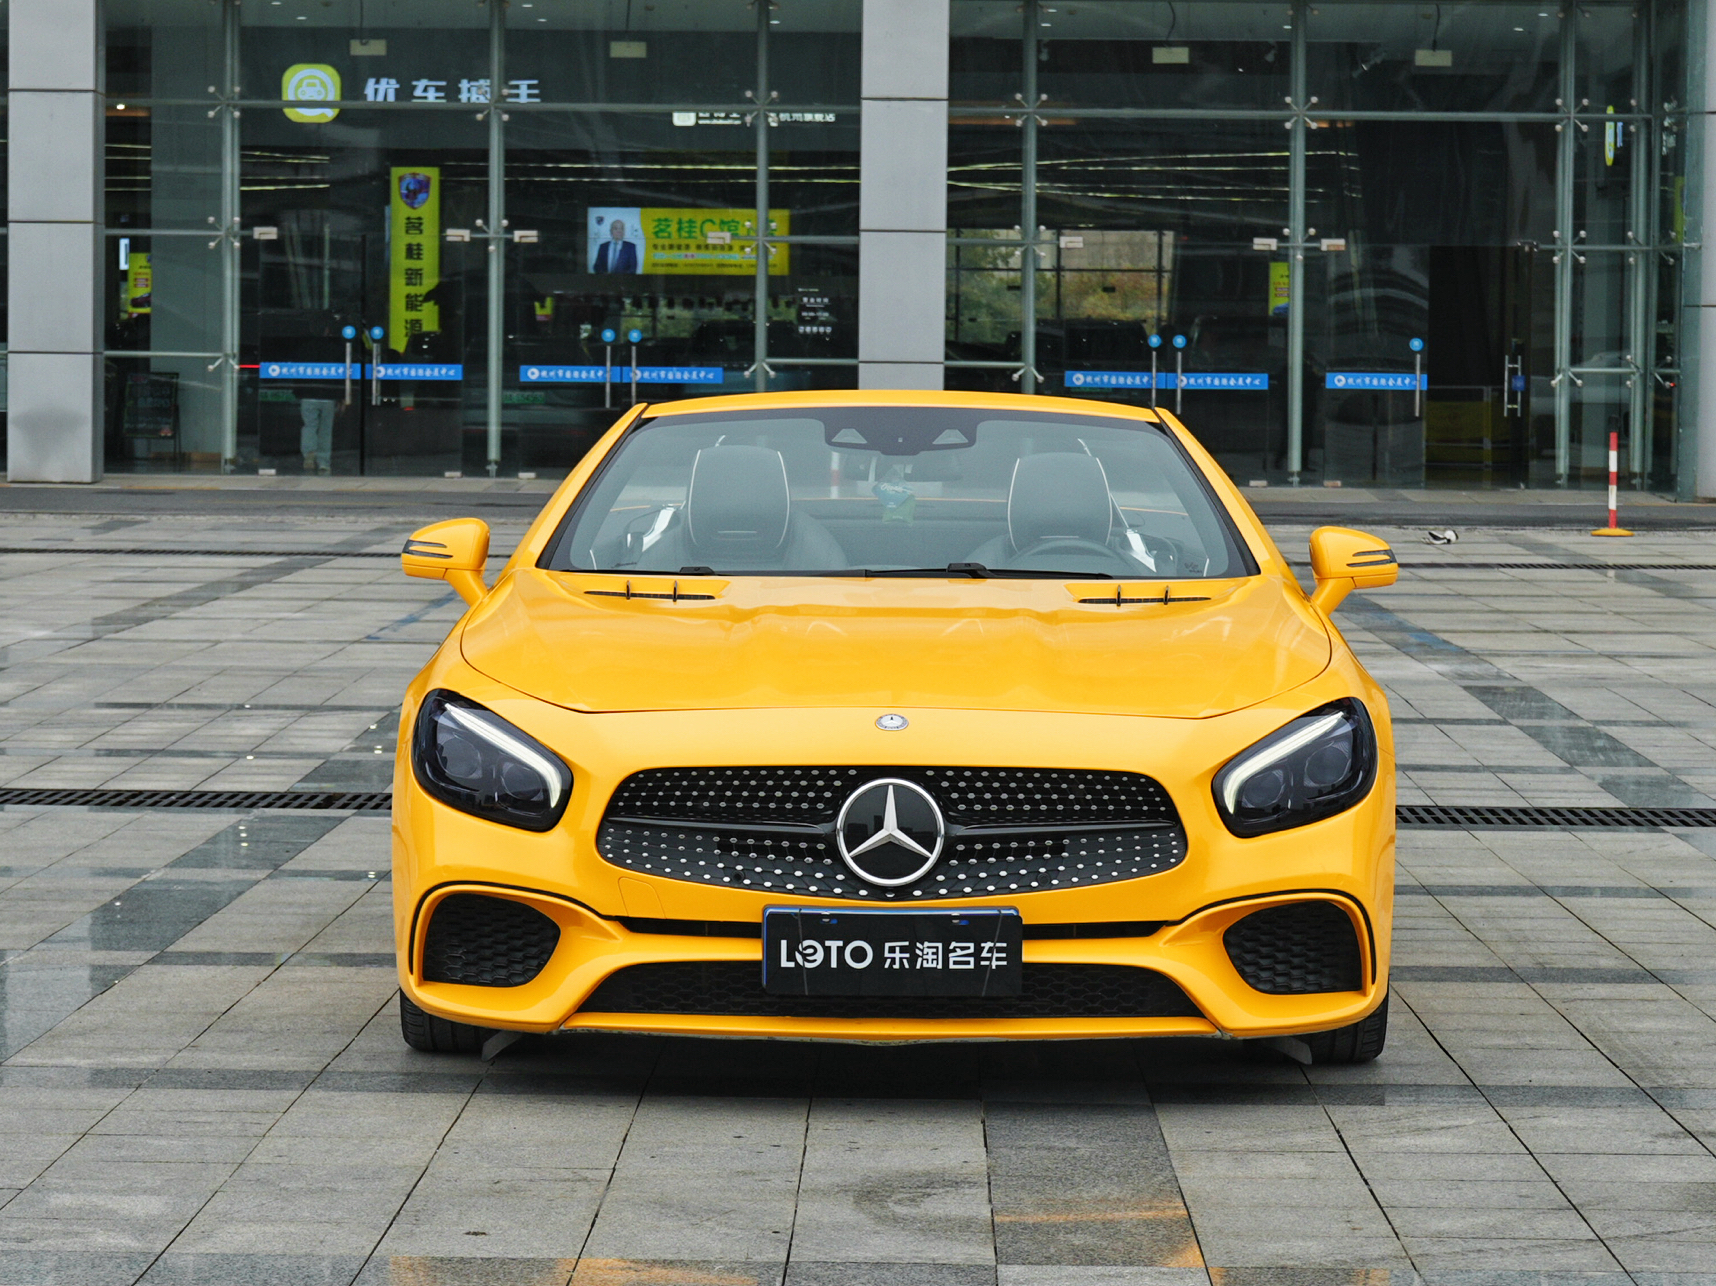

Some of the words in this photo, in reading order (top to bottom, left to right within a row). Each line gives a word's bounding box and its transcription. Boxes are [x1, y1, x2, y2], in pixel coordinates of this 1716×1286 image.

[780, 939, 874, 969] LOTO
[883, 941, 1008, 970] 乐淘名车
